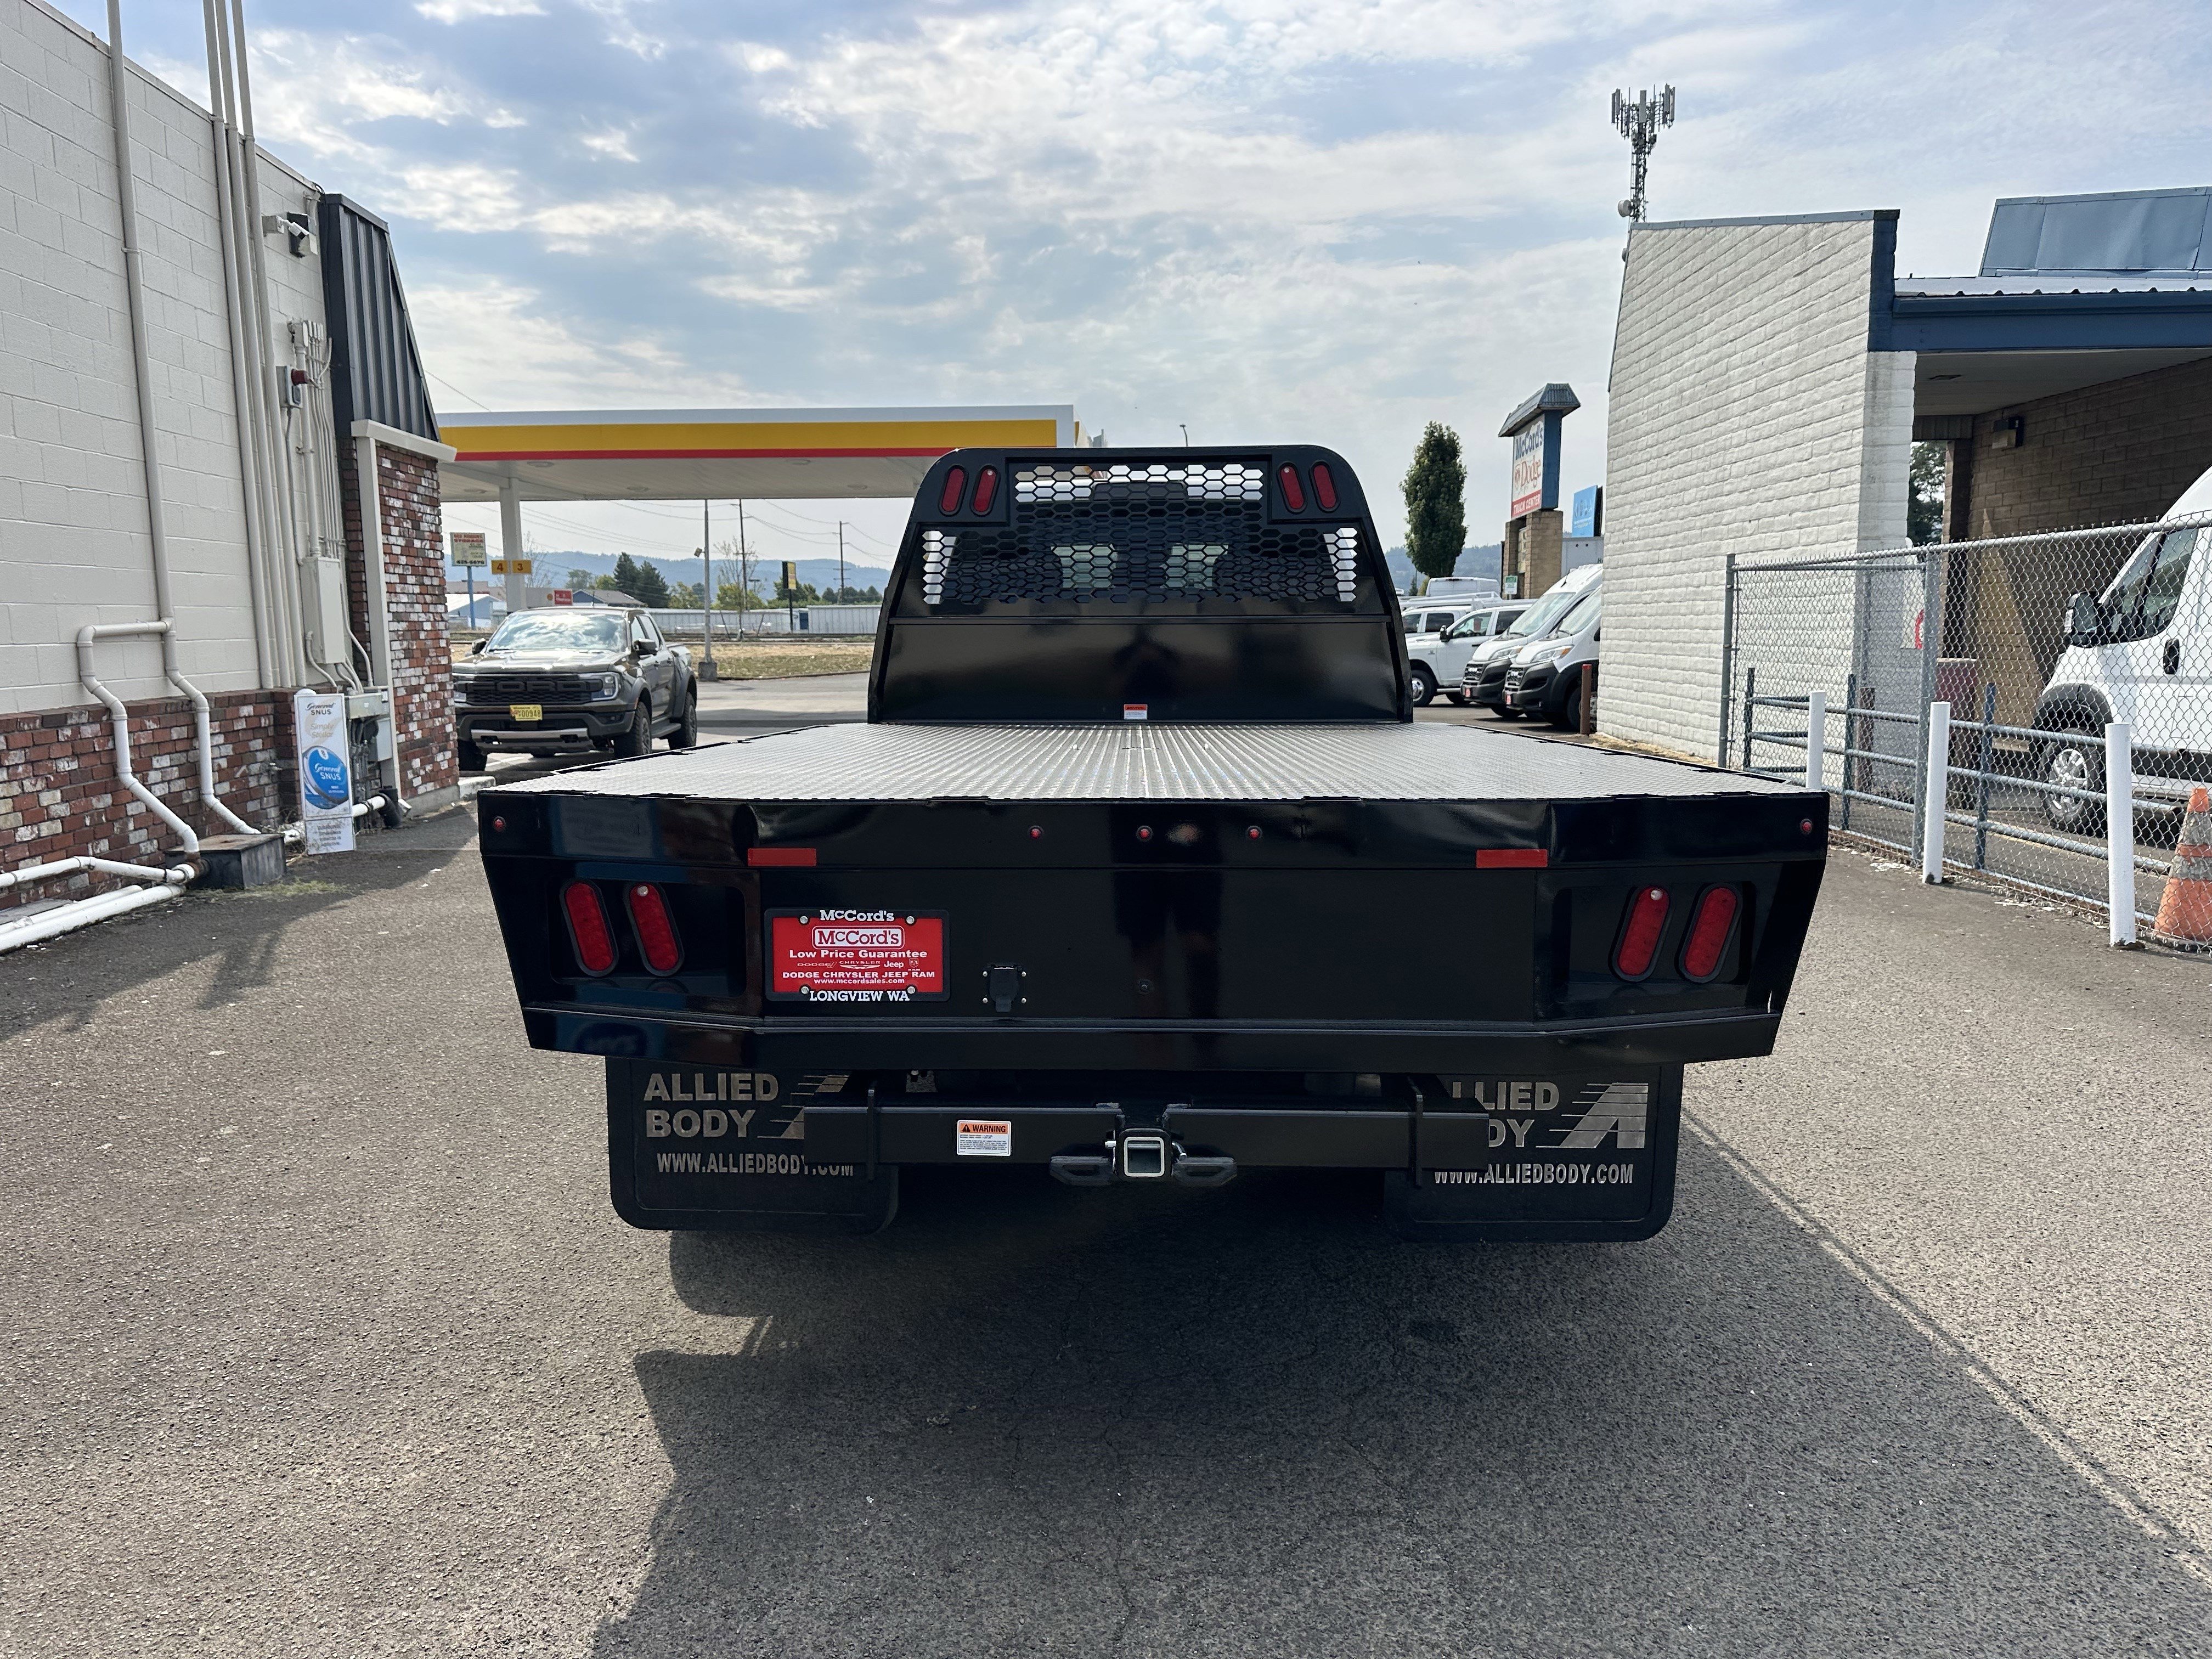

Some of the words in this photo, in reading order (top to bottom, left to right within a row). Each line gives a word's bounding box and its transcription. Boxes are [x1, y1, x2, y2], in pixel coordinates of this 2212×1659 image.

[1515, 424, 1543, 460] McCord's
[1521, 455, 1541, 488] Dodge
[1526, 494, 1541, 509] CENTER
[497, 563, 504, 571] 4
[306, 703, 336, 711] General
[314, 763, 341, 773] General
[320, 772, 342, 781] SNUS
[820, 910, 895, 922] McCord's
[817, 930, 899, 945] McCord's
[789, 950, 816, 958] Low
[821, 950, 854, 958] Price
[859, 950, 928, 958] Guarantee
[809, 990, 883, 1001] LONGVIEW
[887, 991, 910, 1001] WA
[643, 1073, 778, 1101] ALLIED
[1453, 1082, 1559, 1110] LIED
[646, 1110, 756, 1138] BODY
[972, 1124, 1006, 1133] WARNING
[1488, 1119, 1535, 1147] DY
